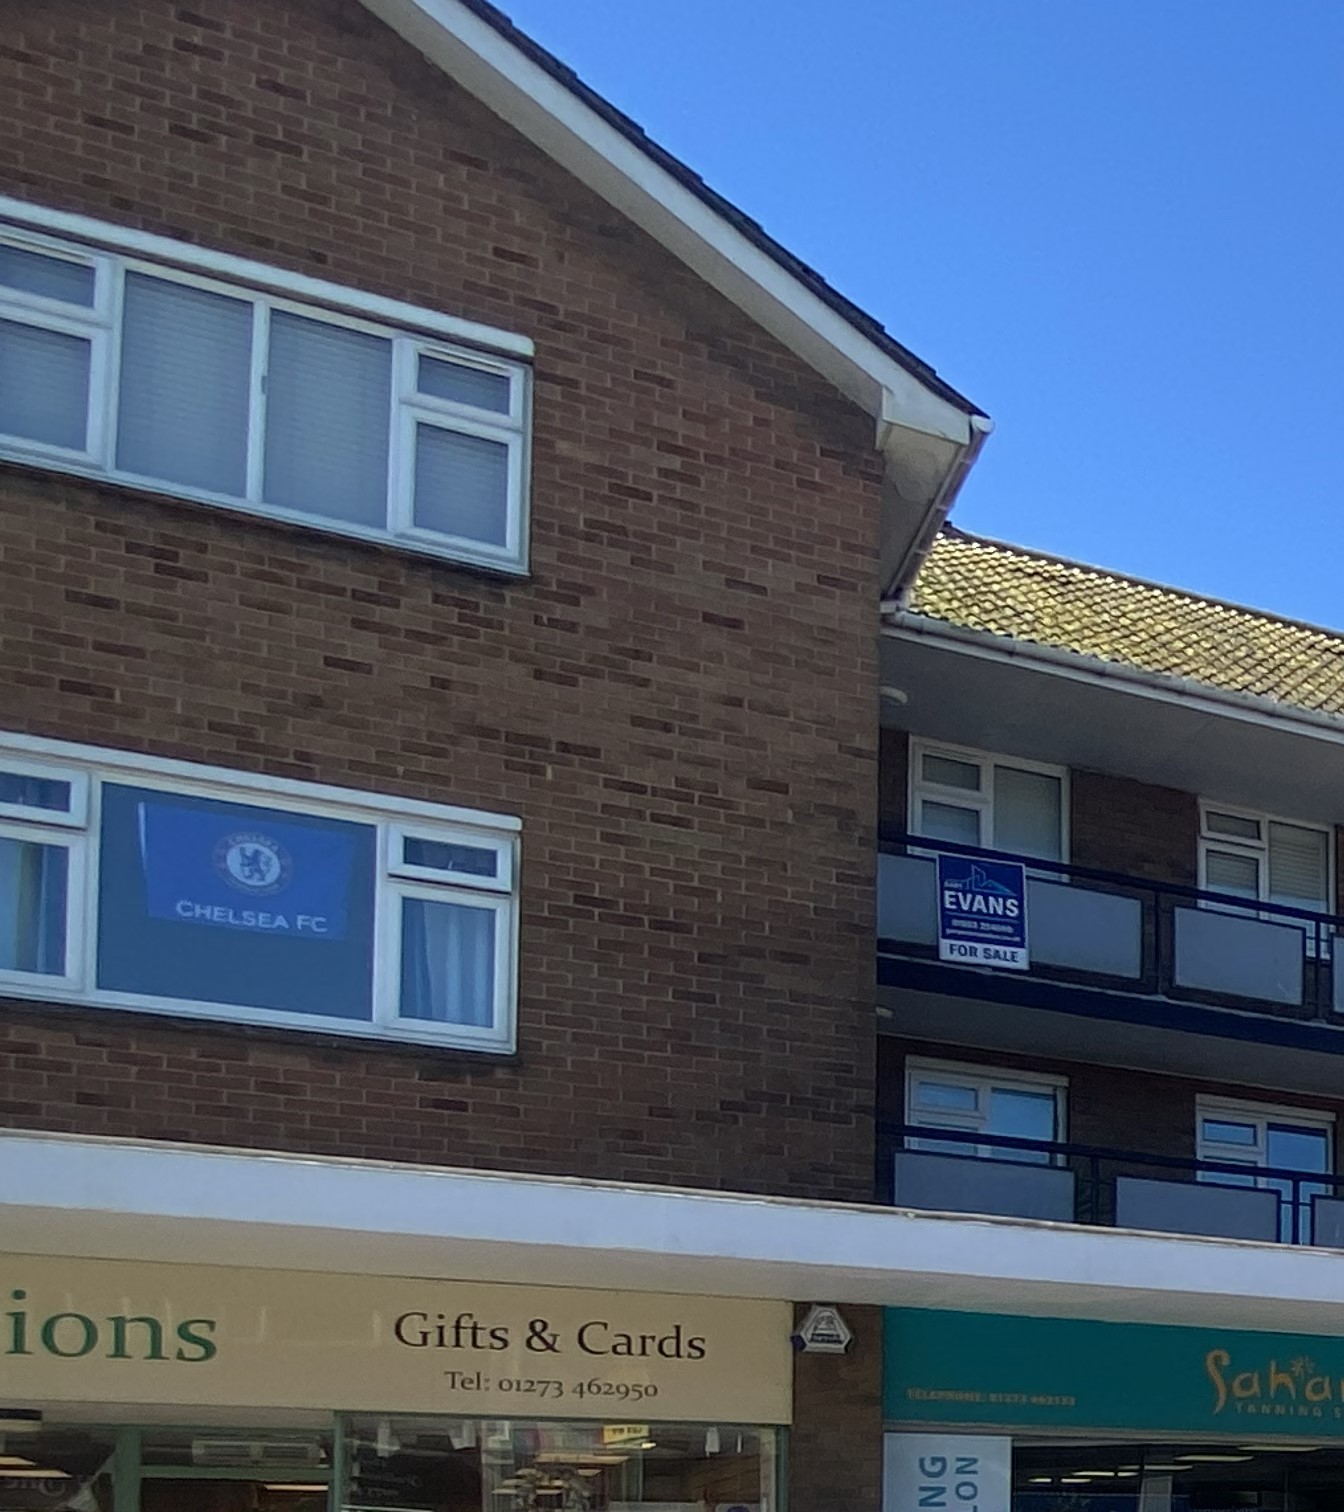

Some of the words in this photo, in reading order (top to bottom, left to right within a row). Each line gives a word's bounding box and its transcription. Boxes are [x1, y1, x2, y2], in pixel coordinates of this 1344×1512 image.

[175, 899, 289, 930] CHELSEA
[297, 914, 328, 933] FC
[943, 890, 1019, 917] EVANS
[949, 943, 978, 959] FOR
[983, 948, 1019, 963] SALE
[3, 1290, 219, 1363] ions
[394, 1311, 511, 1353] Gifts
[525, 1319, 561, 1354] &
[577, 1319, 707, 1362] Cards
[445, 1370, 491, 1393] Tel:
[498, 1377, 565, 1400] 01273
[572, 1378, 660, 1401] 462950
[1235, 1402, 1323, 1418] TANNING
